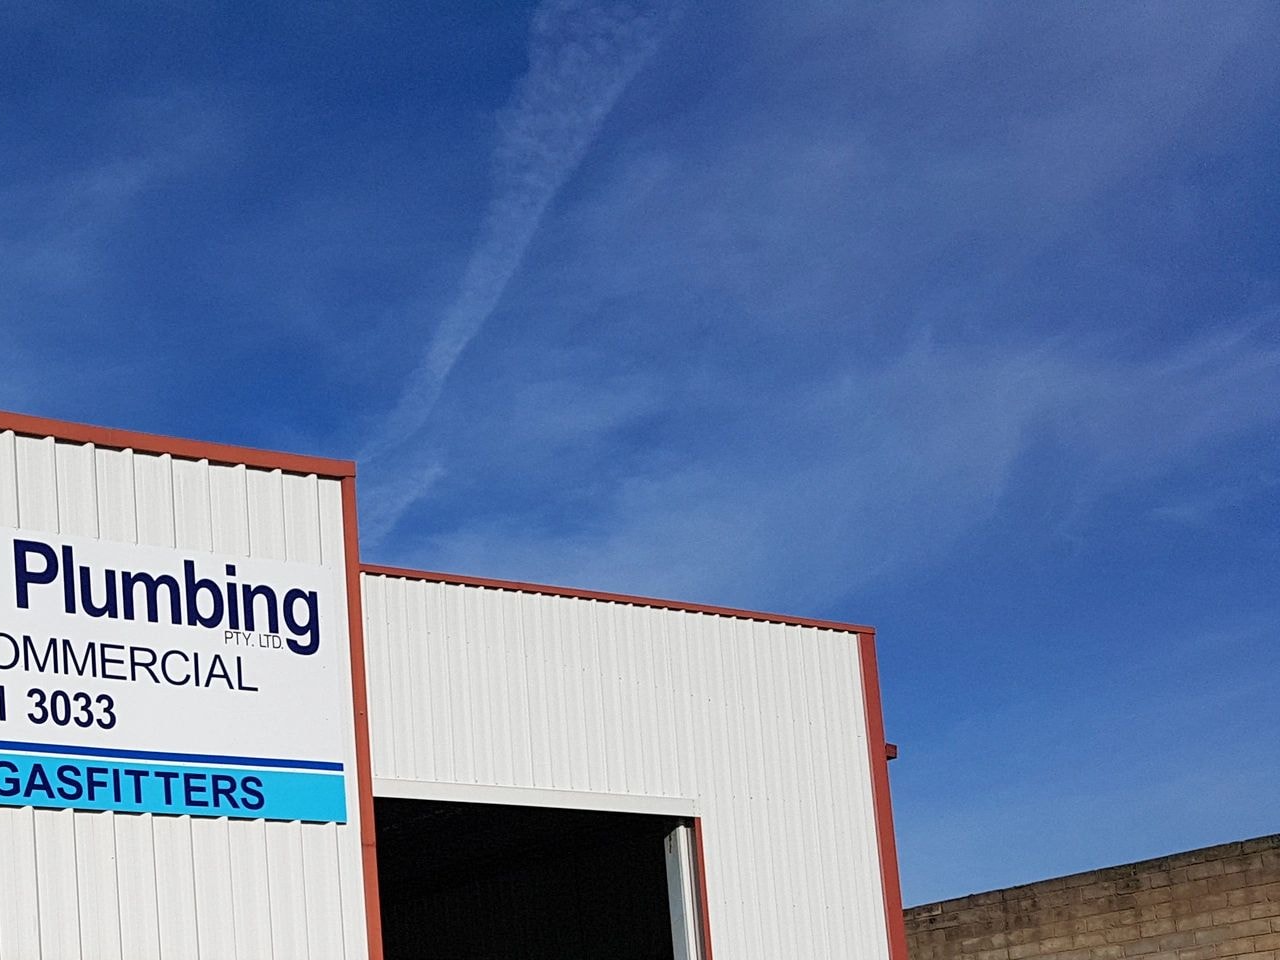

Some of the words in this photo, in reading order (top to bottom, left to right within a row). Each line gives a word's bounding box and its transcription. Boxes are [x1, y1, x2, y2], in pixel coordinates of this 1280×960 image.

[13, 538, 320, 656] Plumbing
[224, 630, 254, 648] PTY.
[258, 635, 283, 650] LTD.
[27, 687, 117, 730] 3033
